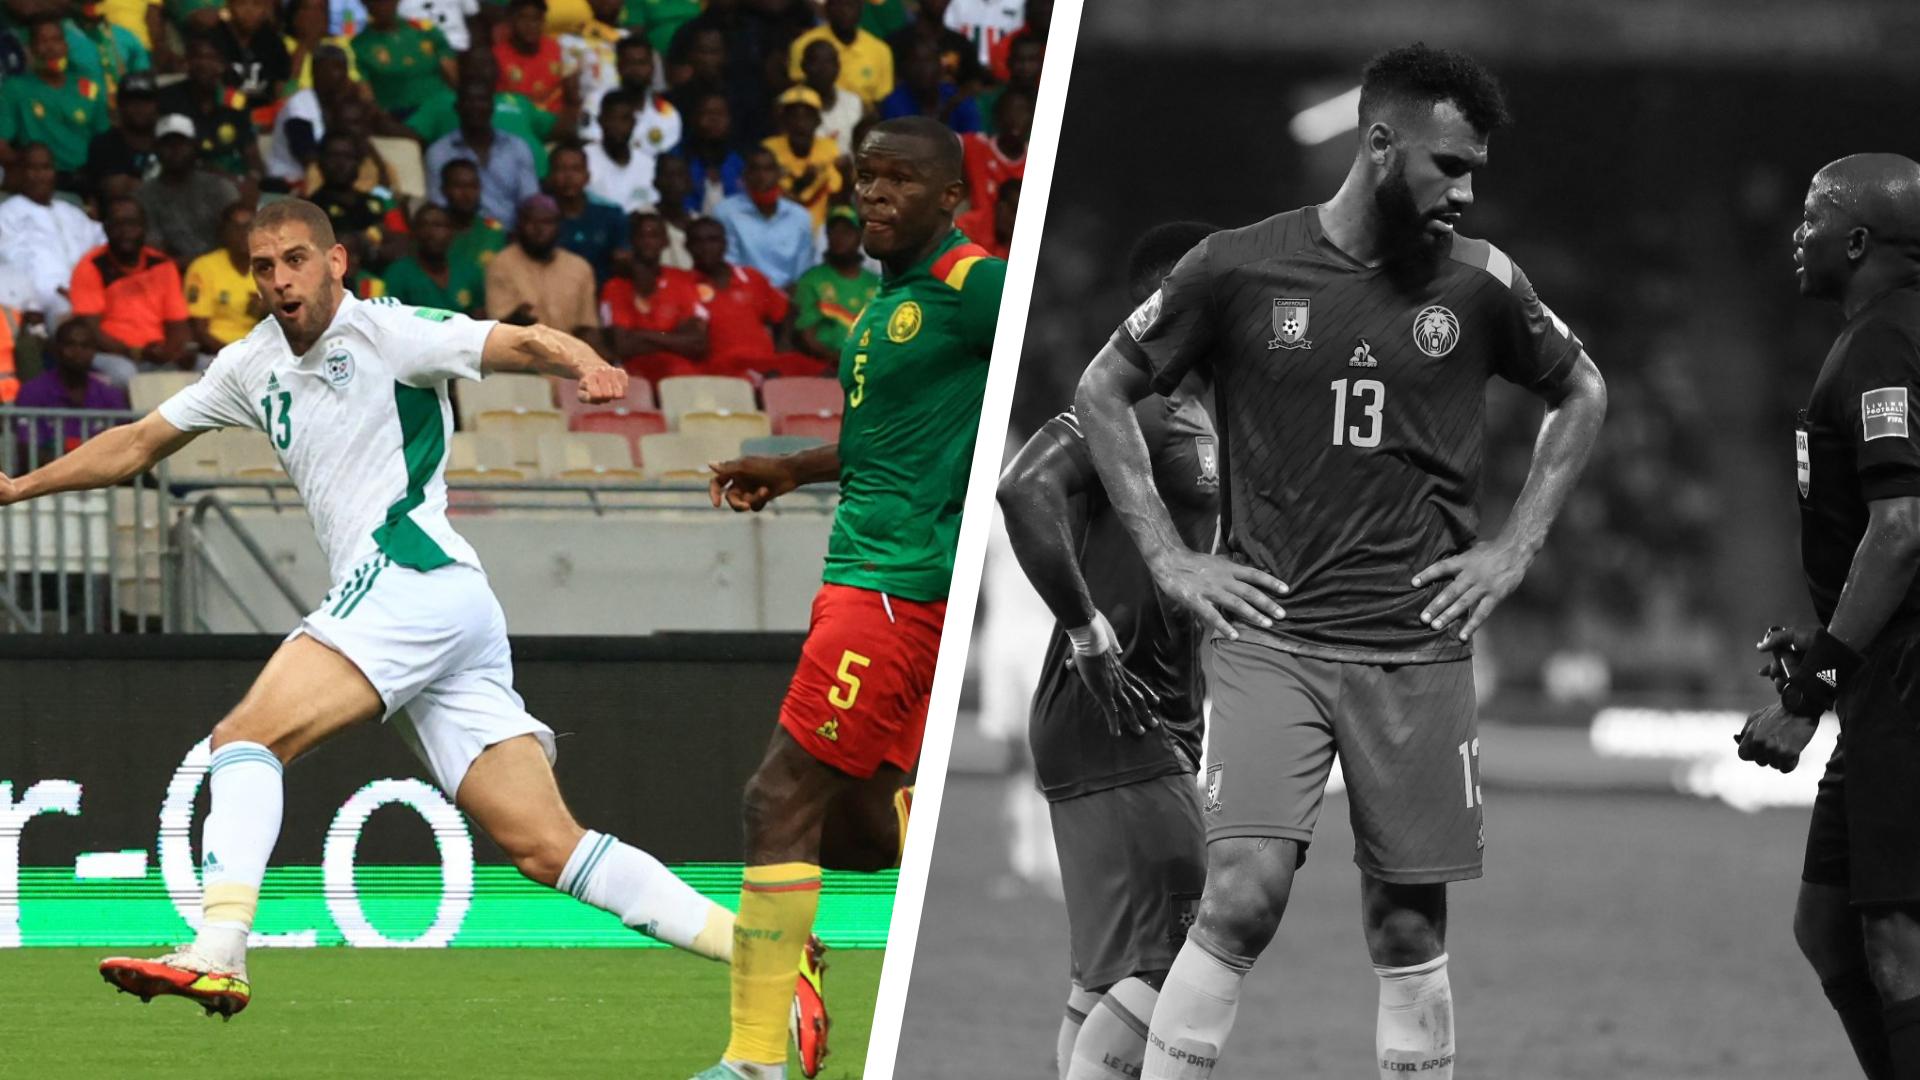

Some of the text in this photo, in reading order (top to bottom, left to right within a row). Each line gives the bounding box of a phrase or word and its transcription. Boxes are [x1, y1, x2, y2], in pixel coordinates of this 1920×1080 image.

[849, 353, 868, 408] 5
[260, 391, 292, 450] 13
[1330, 378, 1385, 448] 13
[1887, 416, 1904, 424] FIFA
[827, 649, 871, 709] 5
[1102, 1051, 1121, 1069] LE
